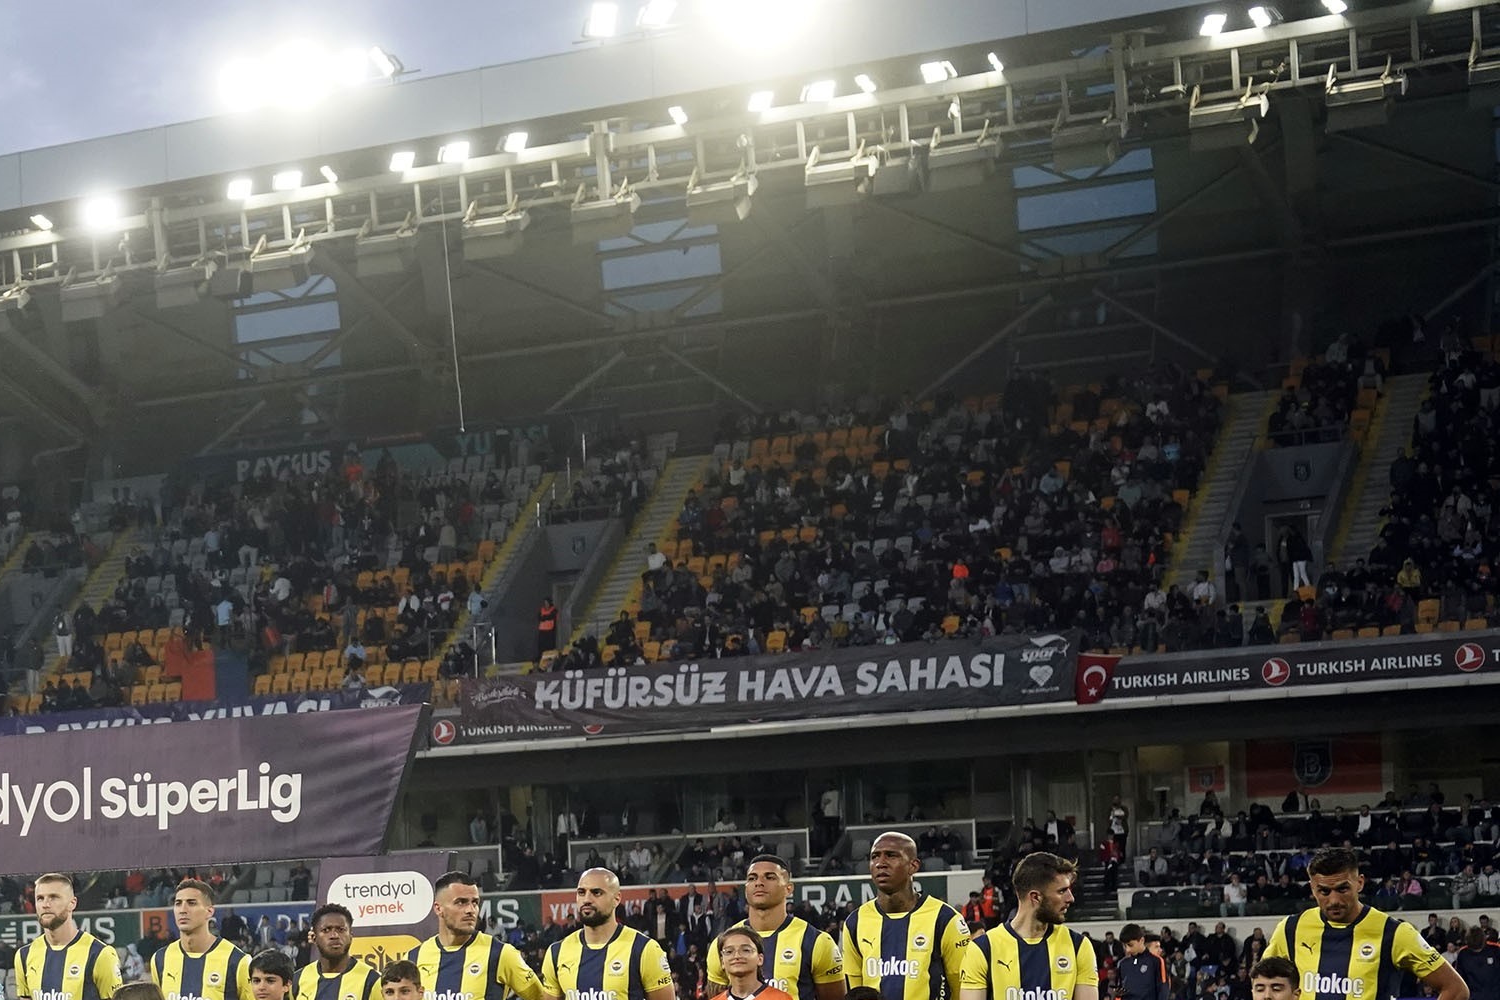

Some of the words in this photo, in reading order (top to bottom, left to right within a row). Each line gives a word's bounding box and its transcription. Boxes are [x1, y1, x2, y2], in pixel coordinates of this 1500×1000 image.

[1296, 658, 1366, 676] TURKISH
[1370, 653, 1443, 671] AIRLINES
[535, 663, 728, 710] KÜFÜRSÜZ
[737, 664, 846, 702] HAVA
[855, 653, 1006, 697] SAHASI
[1112, 672, 1178, 690] TURKISH
[1182, 667, 1250, 685] AIRLINES
[344, 879, 417, 899] trendyol
[358, 901, 405, 918] yemek
[866, 956, 919, 979] Otokoç
[1303, 971, 1365, 998] Otokoç
